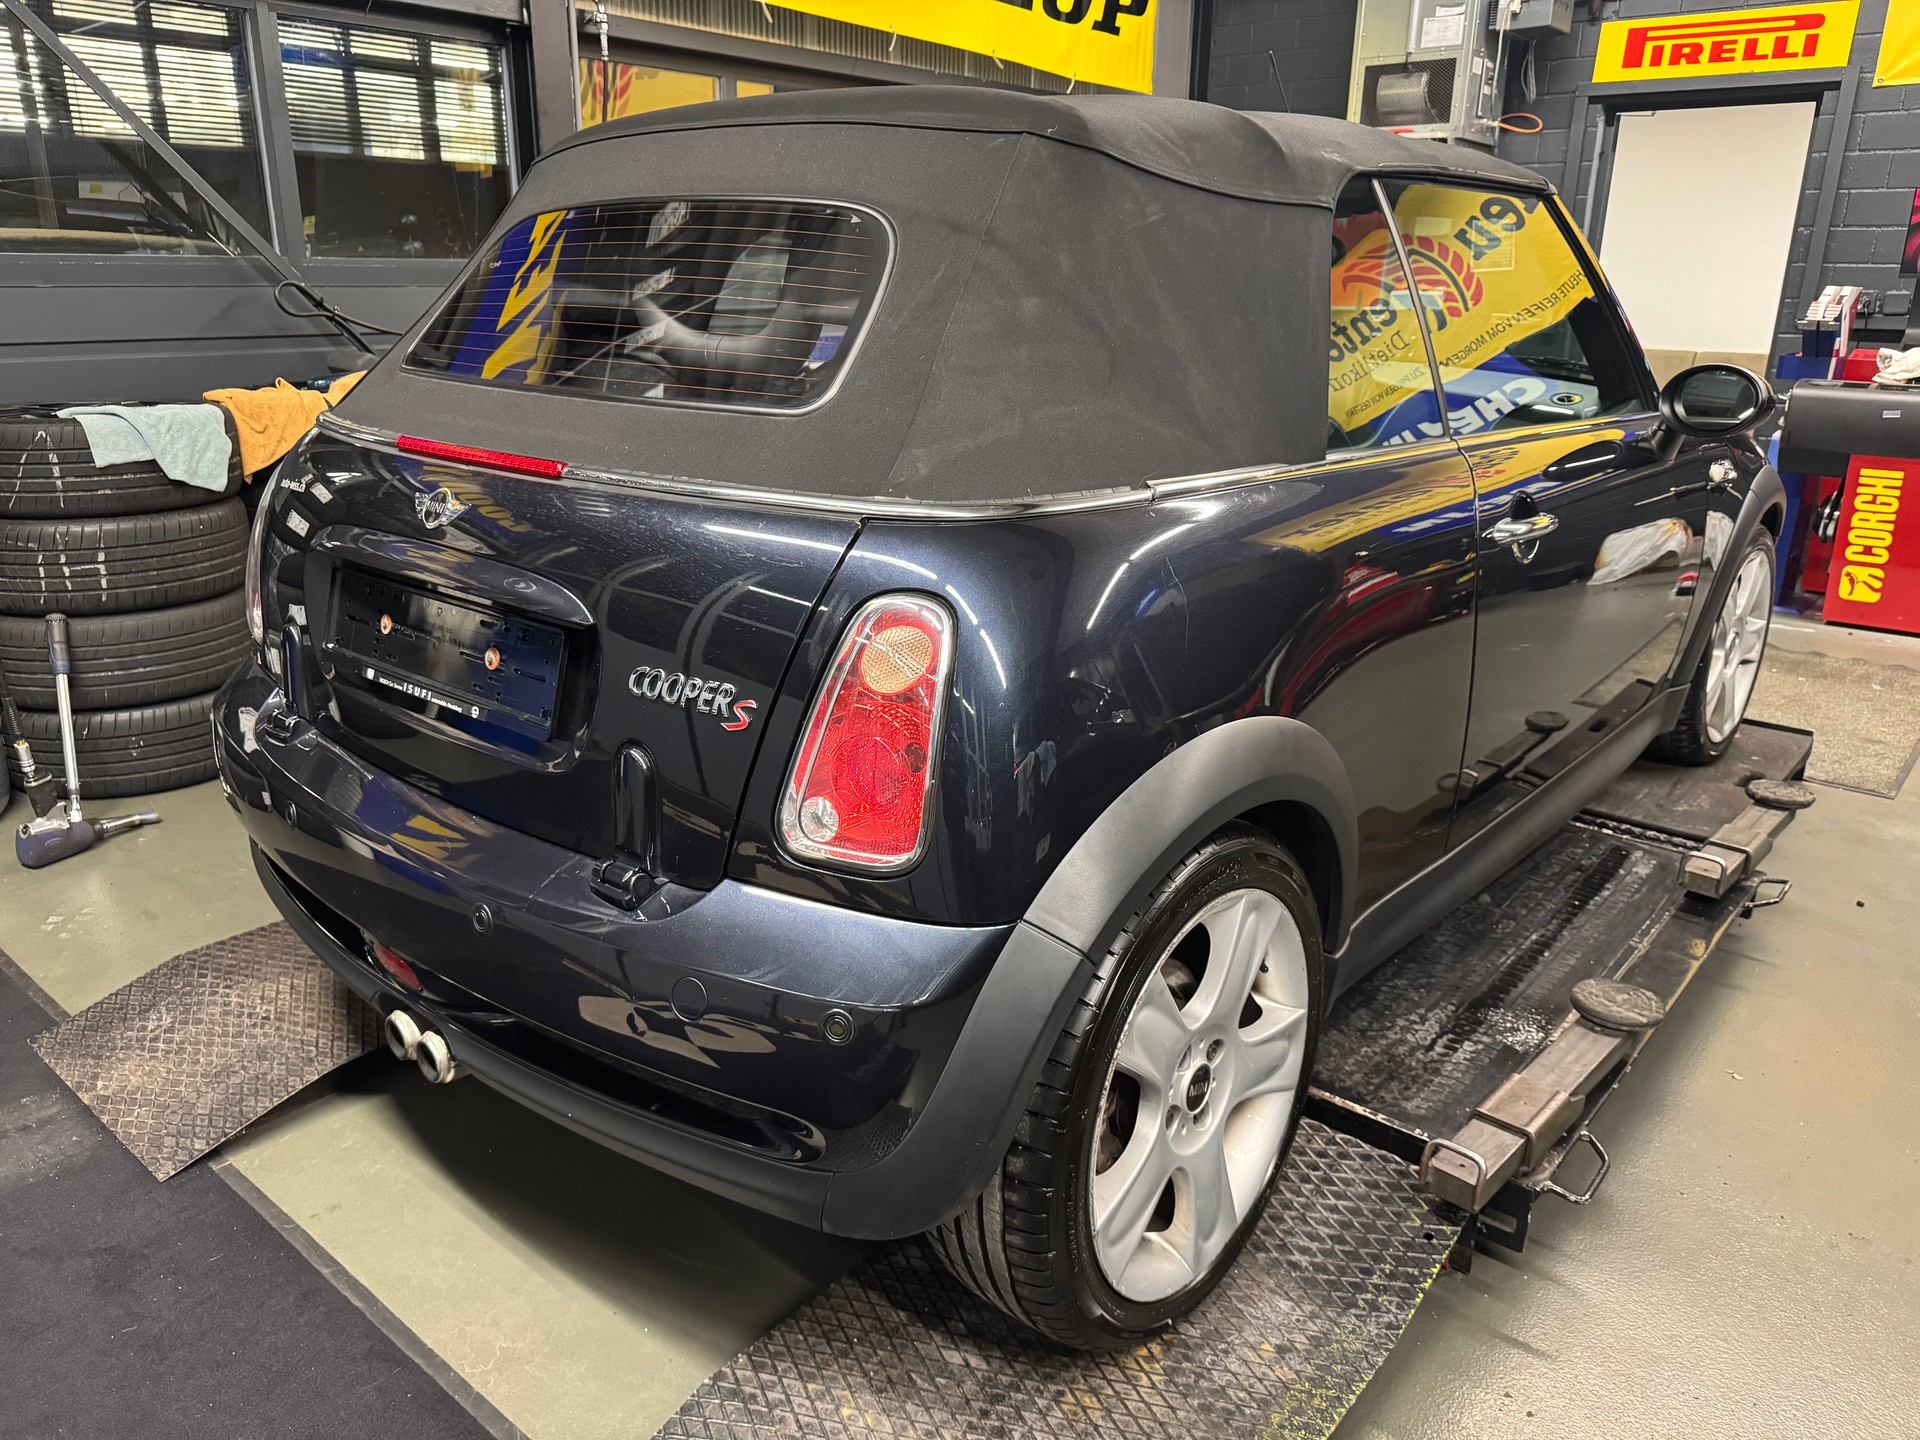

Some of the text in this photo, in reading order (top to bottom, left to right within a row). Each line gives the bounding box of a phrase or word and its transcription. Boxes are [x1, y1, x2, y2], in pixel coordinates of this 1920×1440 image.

[1621, 13, 1826, 69] PIRELLI
[425, 500, 447, 514] MINI
[1844, 468, 1905, 565] CORGHI
[403, 682, 432, 701] ISUFI
[628, 665, 757, 731] COOPER S
